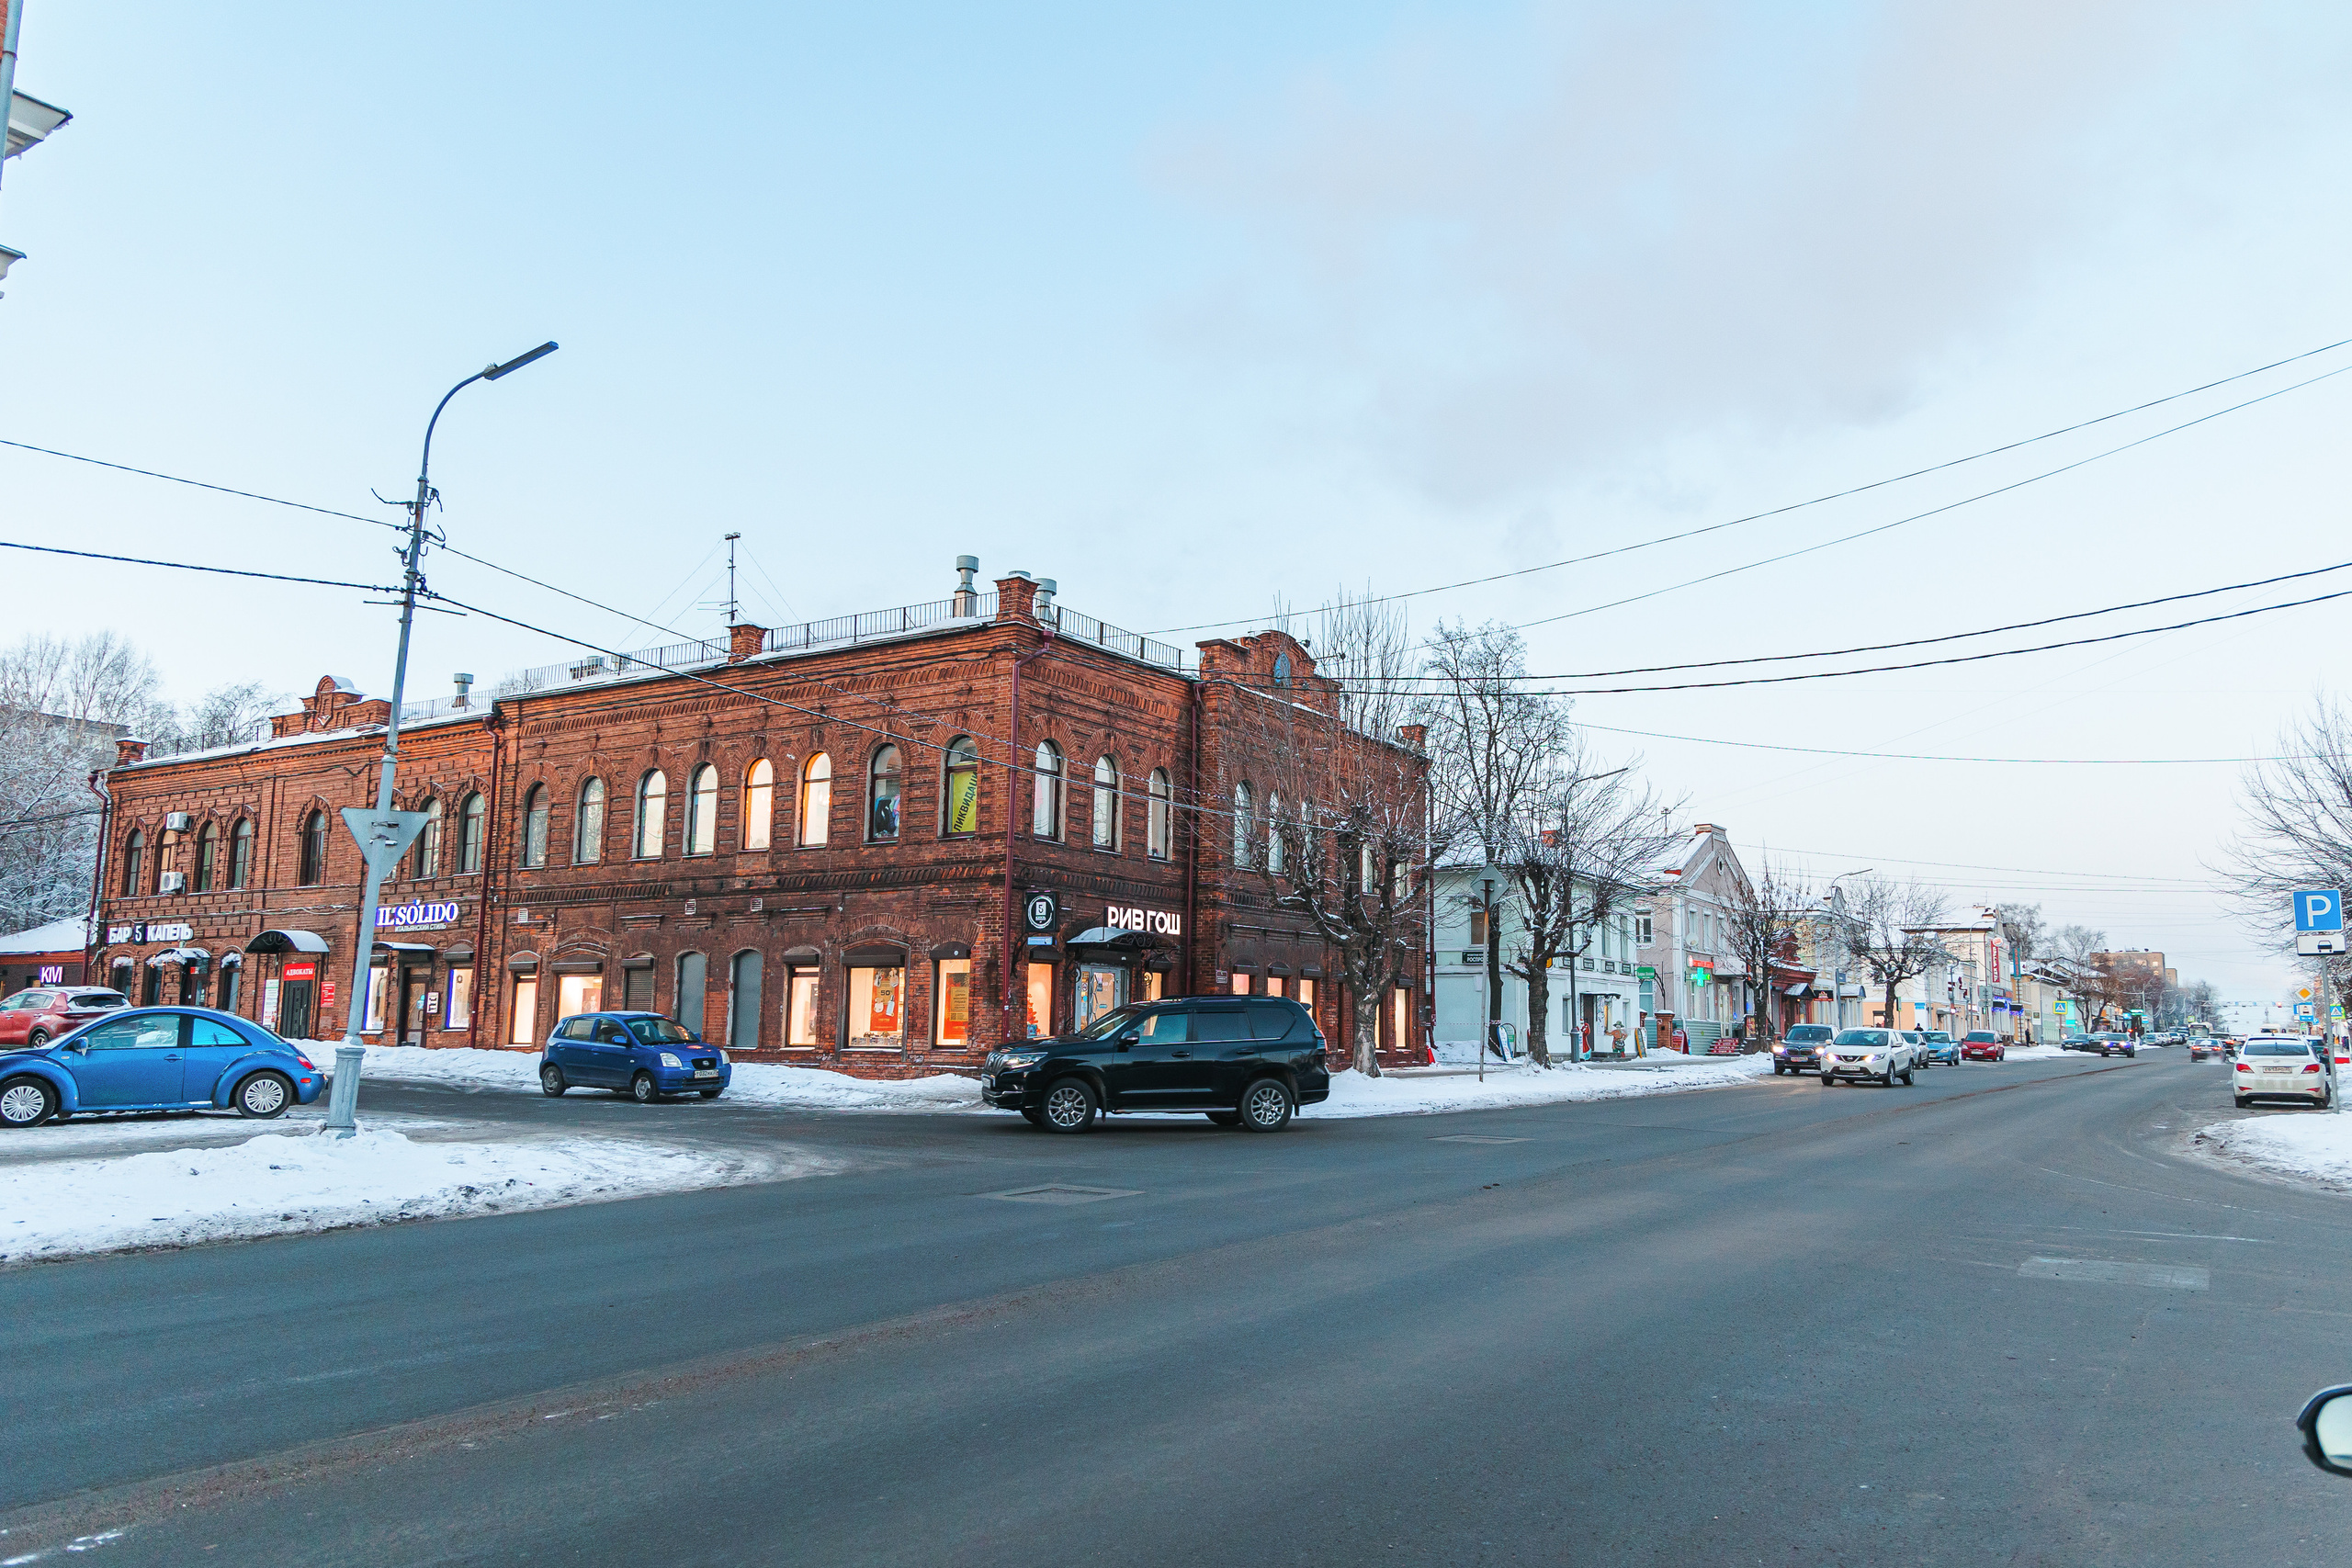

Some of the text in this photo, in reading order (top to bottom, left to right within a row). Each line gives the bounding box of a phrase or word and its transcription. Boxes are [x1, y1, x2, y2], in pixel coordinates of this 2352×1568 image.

[1108, 906, 1181, 935] РИВ ГОШ
[2306, 895, 2332, 928] P
[107, 922, 194, 944] БАР 5 КАПЕЛЬ
[40, 965, 63, 983] KIVI
[286, 967, 313, 976] АДВОКАТЫ
